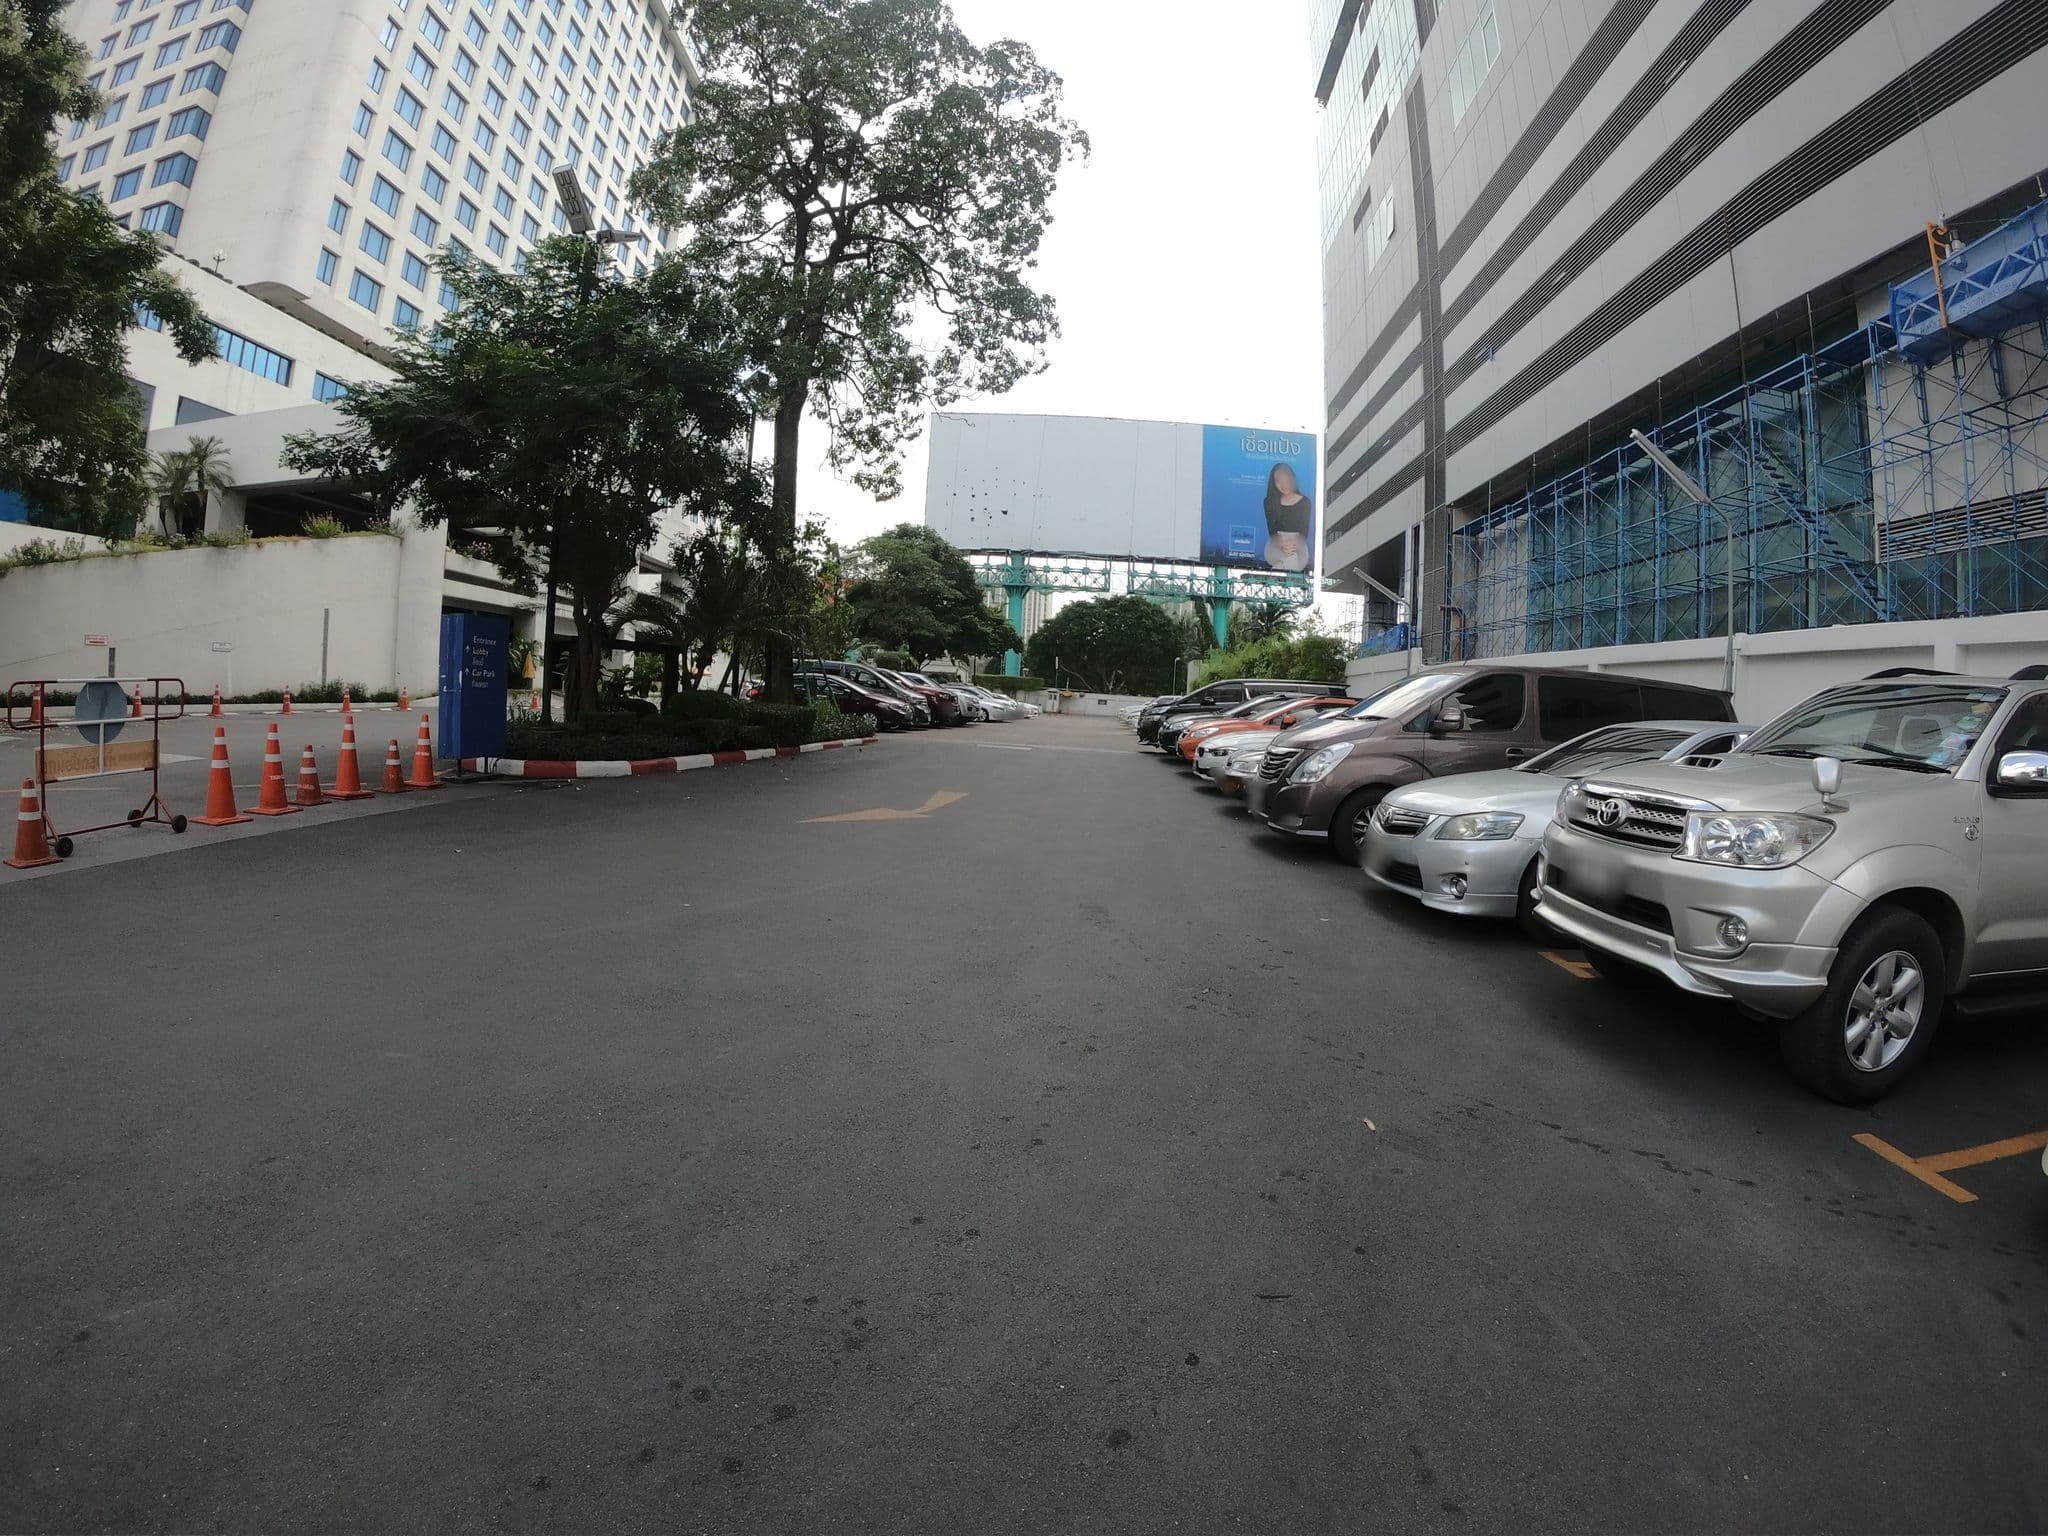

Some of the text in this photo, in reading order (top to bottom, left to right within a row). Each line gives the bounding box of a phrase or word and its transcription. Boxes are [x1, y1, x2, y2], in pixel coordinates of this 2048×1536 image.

[473, 636, 497, 646] Entrance
[473, 647, 488, 657] Lobby
[472, 669, 495, 678] Car Park
